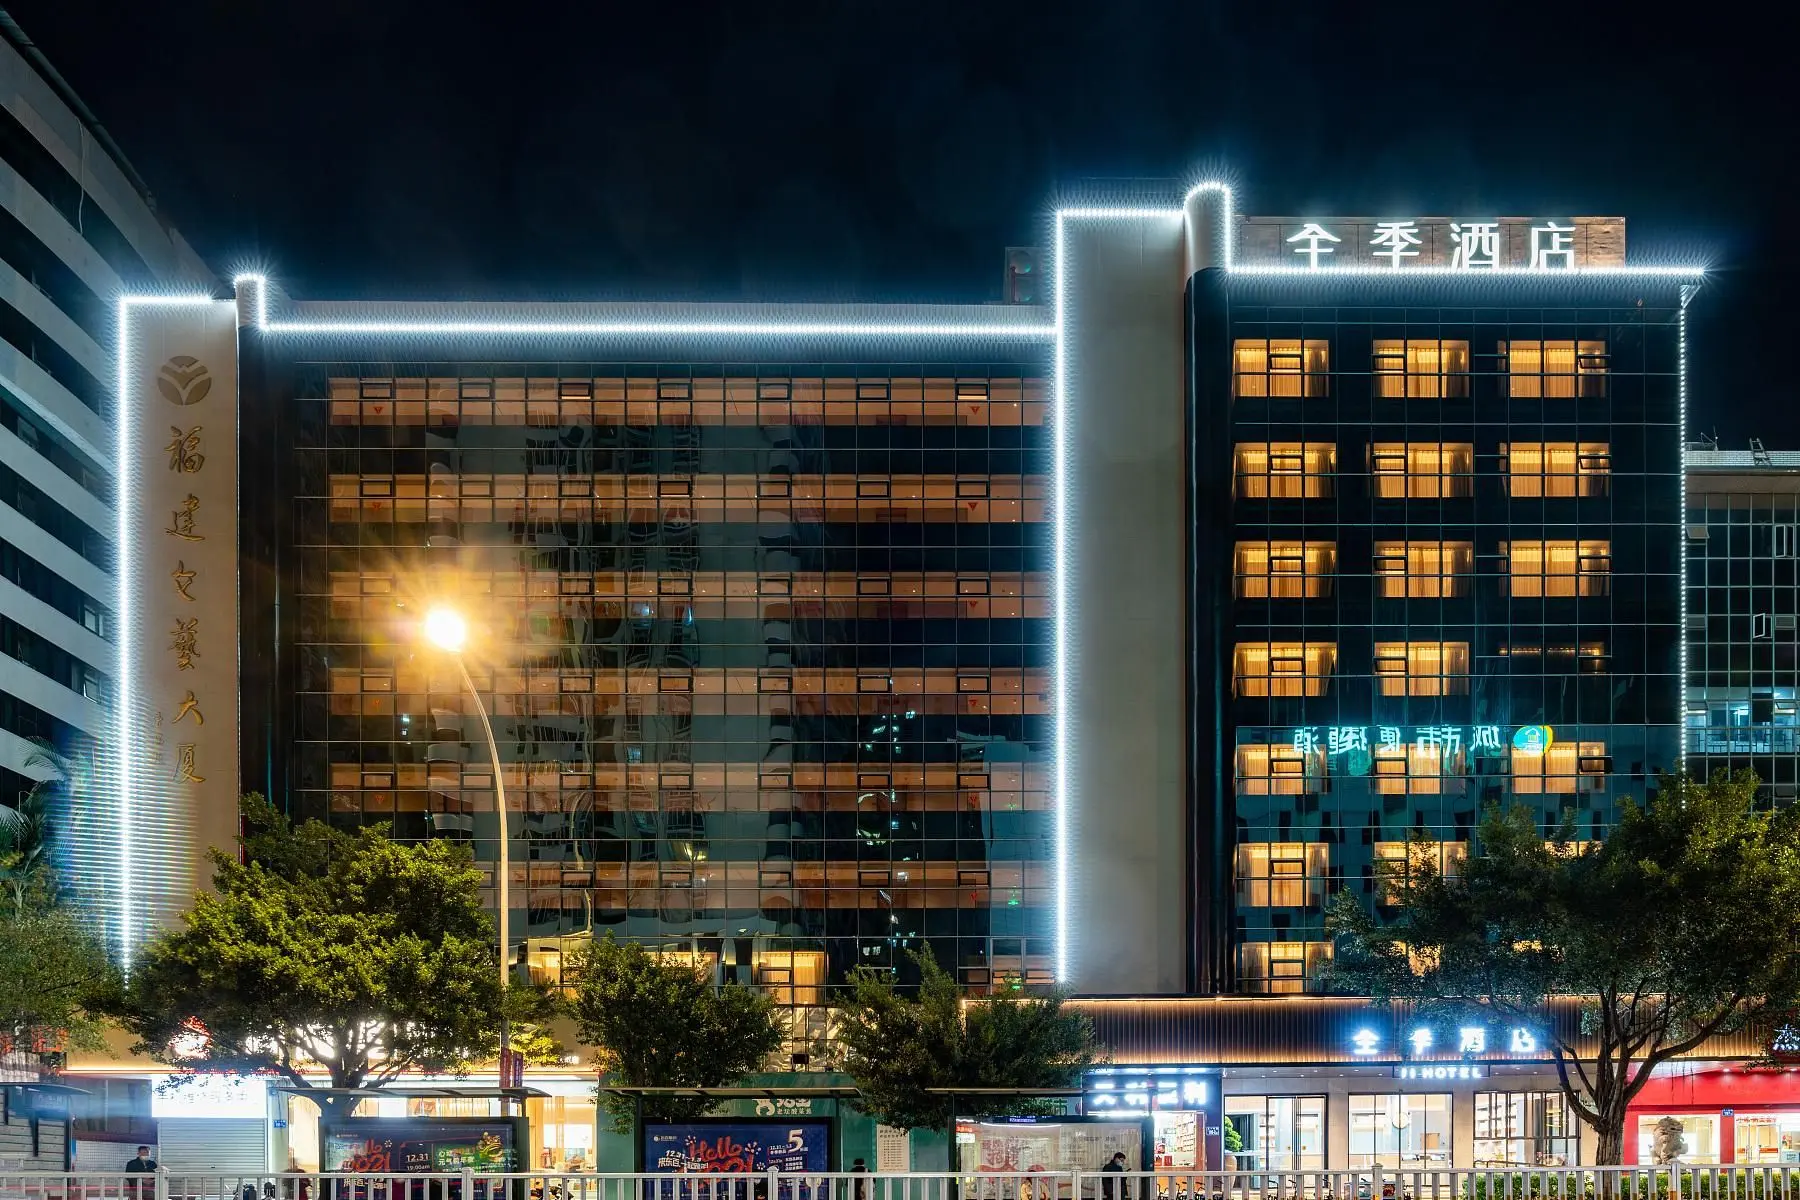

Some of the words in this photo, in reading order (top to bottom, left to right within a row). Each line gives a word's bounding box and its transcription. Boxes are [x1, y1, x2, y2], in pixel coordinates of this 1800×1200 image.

[1286, 221, 1576, 273] 全季酒店
[1421, 1067, 1482, 1079] HOTEL
